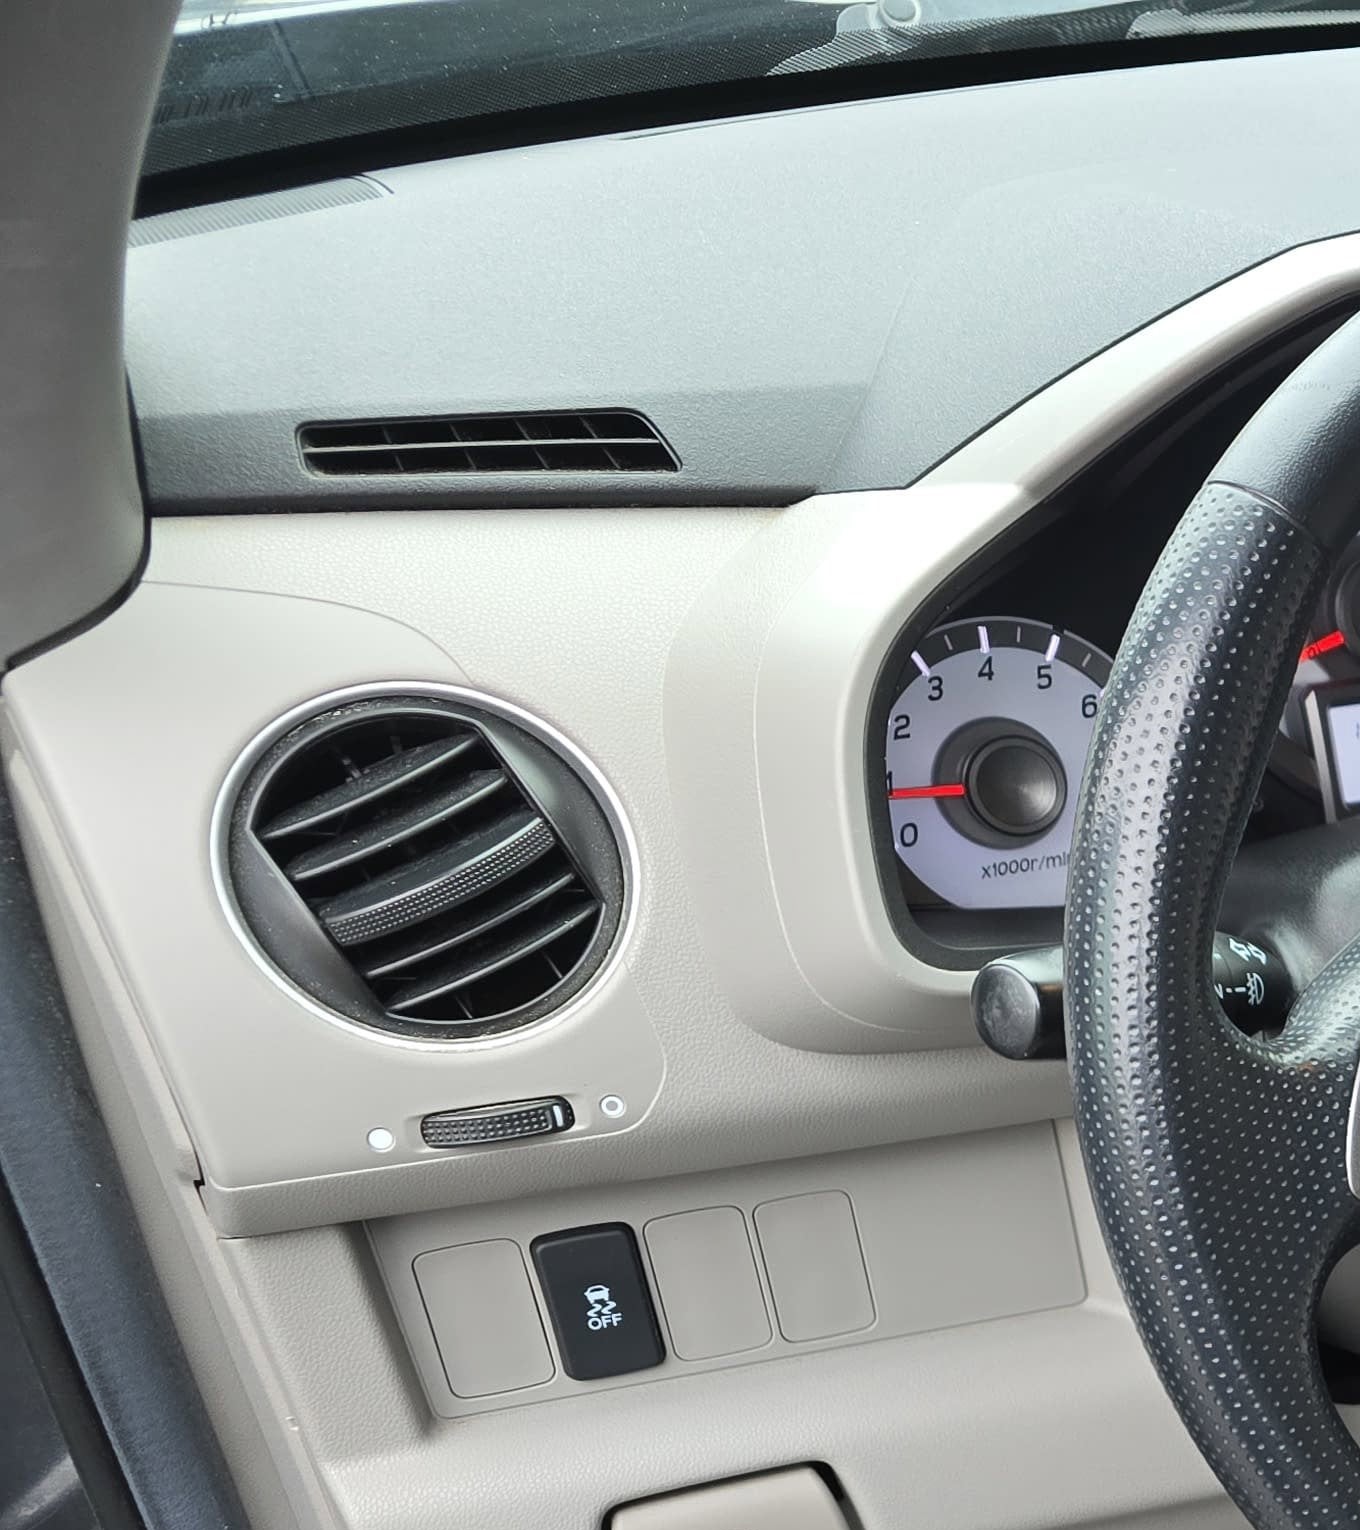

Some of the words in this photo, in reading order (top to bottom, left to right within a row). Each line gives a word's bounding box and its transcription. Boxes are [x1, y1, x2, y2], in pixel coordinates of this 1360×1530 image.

[977, 656, 995, 681] 4
[1037, 665, 1053, 690] 5
[927, 676, 944, 701] 3
[1081, 694, 1098, 719] 6
[893, 714, 912, 740] 2
[900, 822, 919, 848] 0
[981, 851, 1074, 880] x1000r/mi
[588, 1314, 622, 1331] OFF
